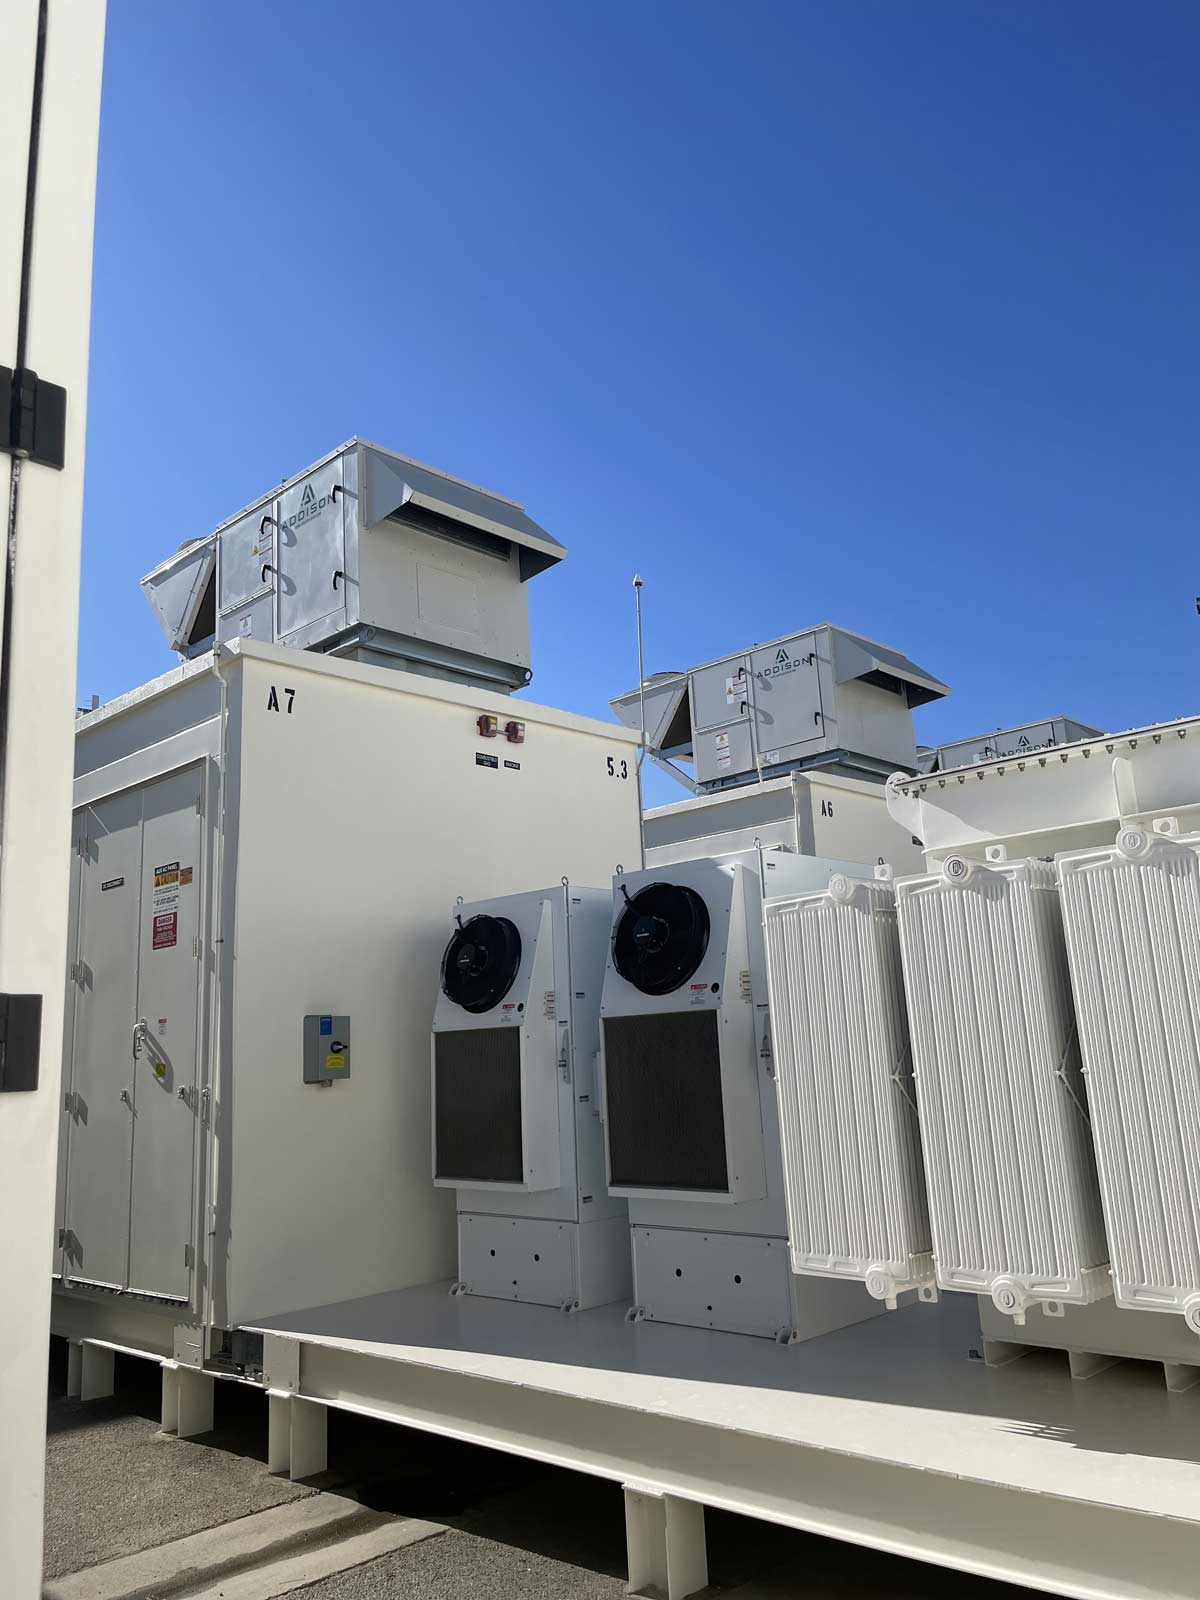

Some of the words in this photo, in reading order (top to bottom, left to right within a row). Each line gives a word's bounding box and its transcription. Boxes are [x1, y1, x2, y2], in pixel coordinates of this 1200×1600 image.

[282, 494, 335, 531] ADDISON
[757, 656, 810, 679] ADDISON
[267, 685, 296, 714] A7
[607, 756, 628, 780] 5.3
[821, 799, 834, 818] A6
